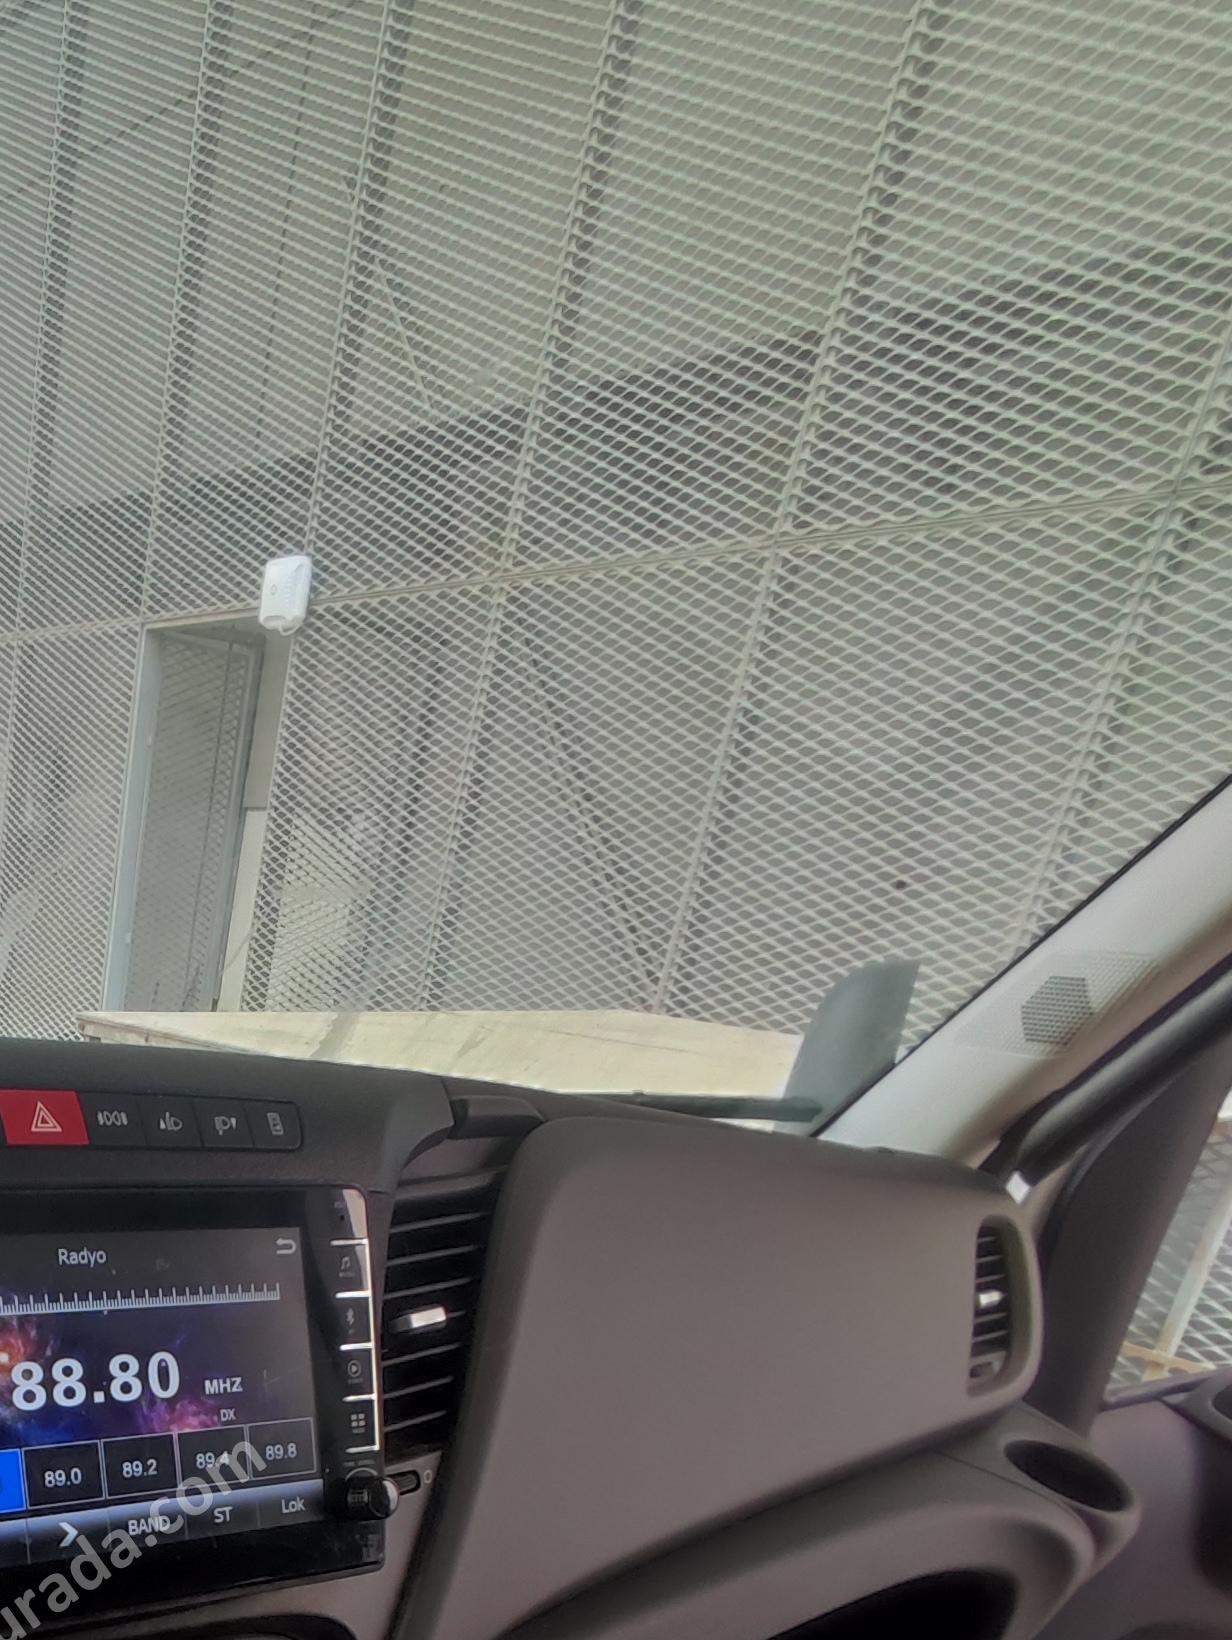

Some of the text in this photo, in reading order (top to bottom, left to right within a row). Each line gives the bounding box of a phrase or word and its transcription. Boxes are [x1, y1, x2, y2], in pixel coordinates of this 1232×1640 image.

[57, 1247, 107, 1269] Radyo
[10, 1351, 181, 1412] 88.80
[204, 1376, 244, 1396] MHZ
[220, 1408, 236, 1422] DX
[43, 1467, 82, 1488] 89.0
[121, 1458, 158, 1479] 89.2
[265, 1442, 298, 1461] 89.8
[127, 1515, 172, 1537] BAND
[213, 1505, 234, 1524] ST
[281, 1497, 306, 1515] Lok
